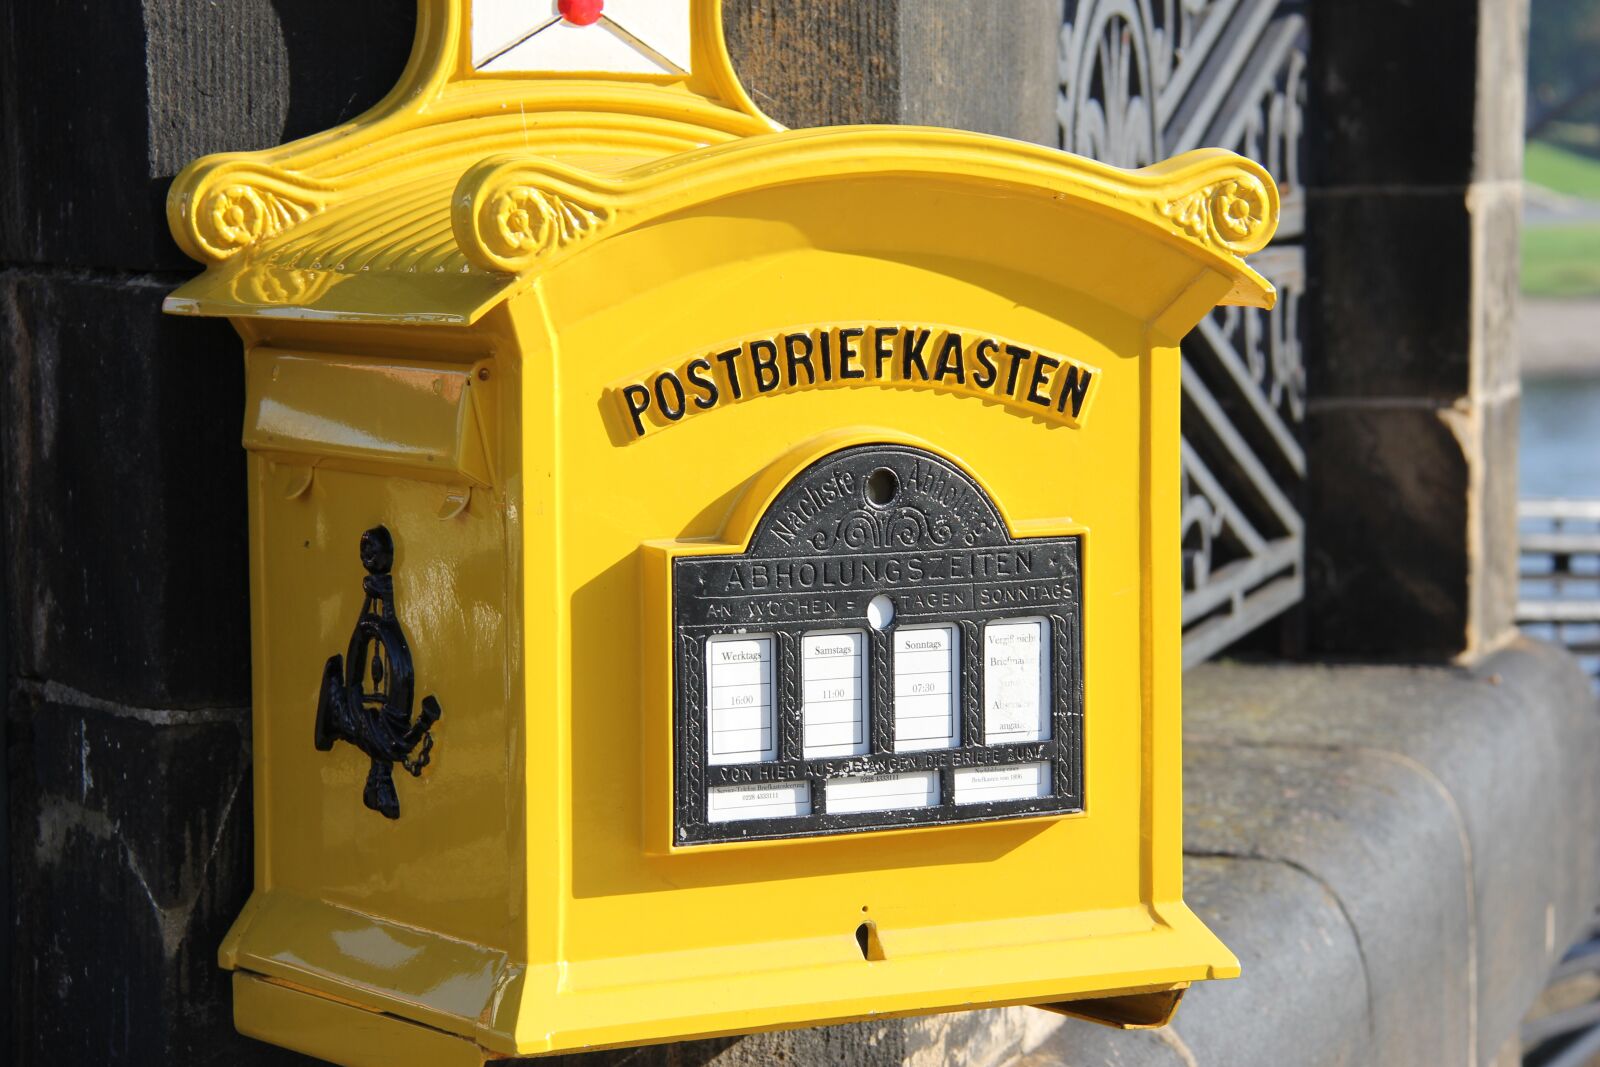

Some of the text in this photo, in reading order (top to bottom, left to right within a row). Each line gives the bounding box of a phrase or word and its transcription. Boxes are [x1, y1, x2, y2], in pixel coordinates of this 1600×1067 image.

[622, 327, 1093, 435] POSTBRIEFKASTEN
[725, 551, 1032, 591] ABHOLUNGSZEITEN
[980, 583, 1073, 606] SONNTAGS
[706, 603, 731, 618] AN
[900, 593, 965, 610] TAGEN
[905, 640, 942, 650] Sonntags
[722, 651, 762, 662] Werktags
[814, 646, 852, 656] Samstags
[912, 683, 935, 693] 07:30
[823, 689, 845, 699] 11:00
[731, 695, 754, 706] 16:00
[760, 764, 797, 780] HIER
[804, 762, 834, 777] AUS
[952, 750, 1000, 767] BRIEFE
